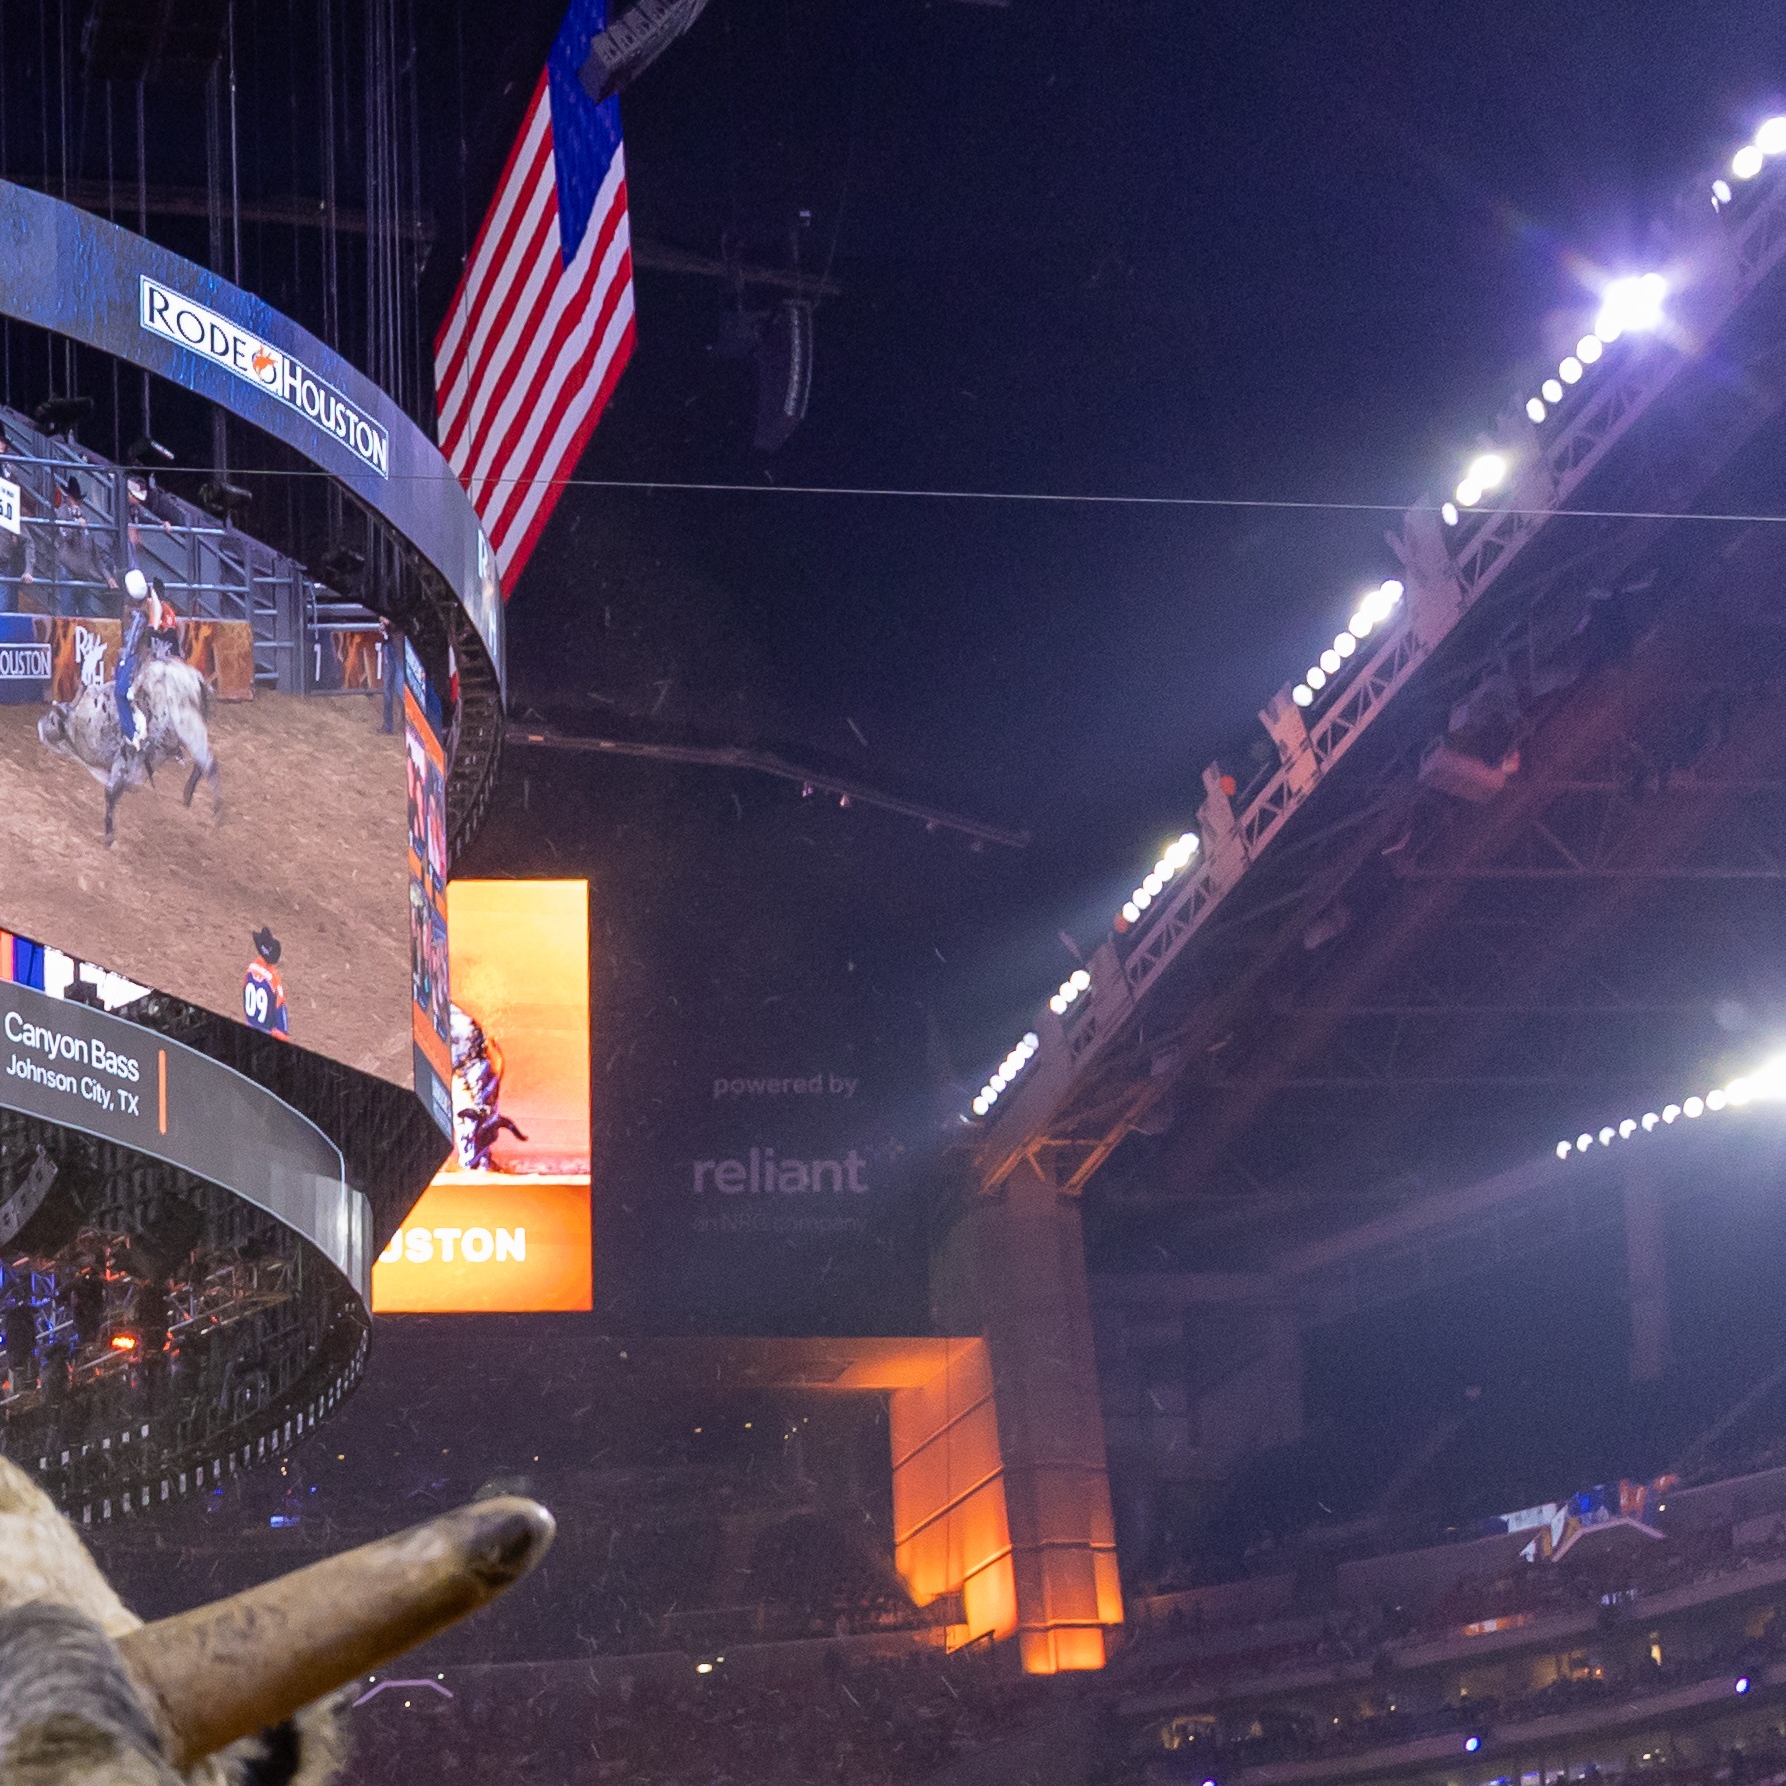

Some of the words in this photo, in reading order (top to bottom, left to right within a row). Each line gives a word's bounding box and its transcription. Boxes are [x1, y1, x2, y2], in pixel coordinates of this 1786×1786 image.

[148, 285, 276, 385] RODEO
[283, 358, 387, 475] HOUSTON
[244, 982, 269, 1024] 09
[4, 1011, 88, 1064] Canyon
[91, 1039, 140, 1083] Bass
[6, 1054, 77, 1095] Johnson
[81, 1076, 115, 1112] City,
[117, 1087, 140, 1117] TX
[714, 1072, 823, 1100] powered
[829, 1071, 860, 1099] by
[692, 1147, 869, 1195] reliant
[379, 1227, 525, 1263] USTON
